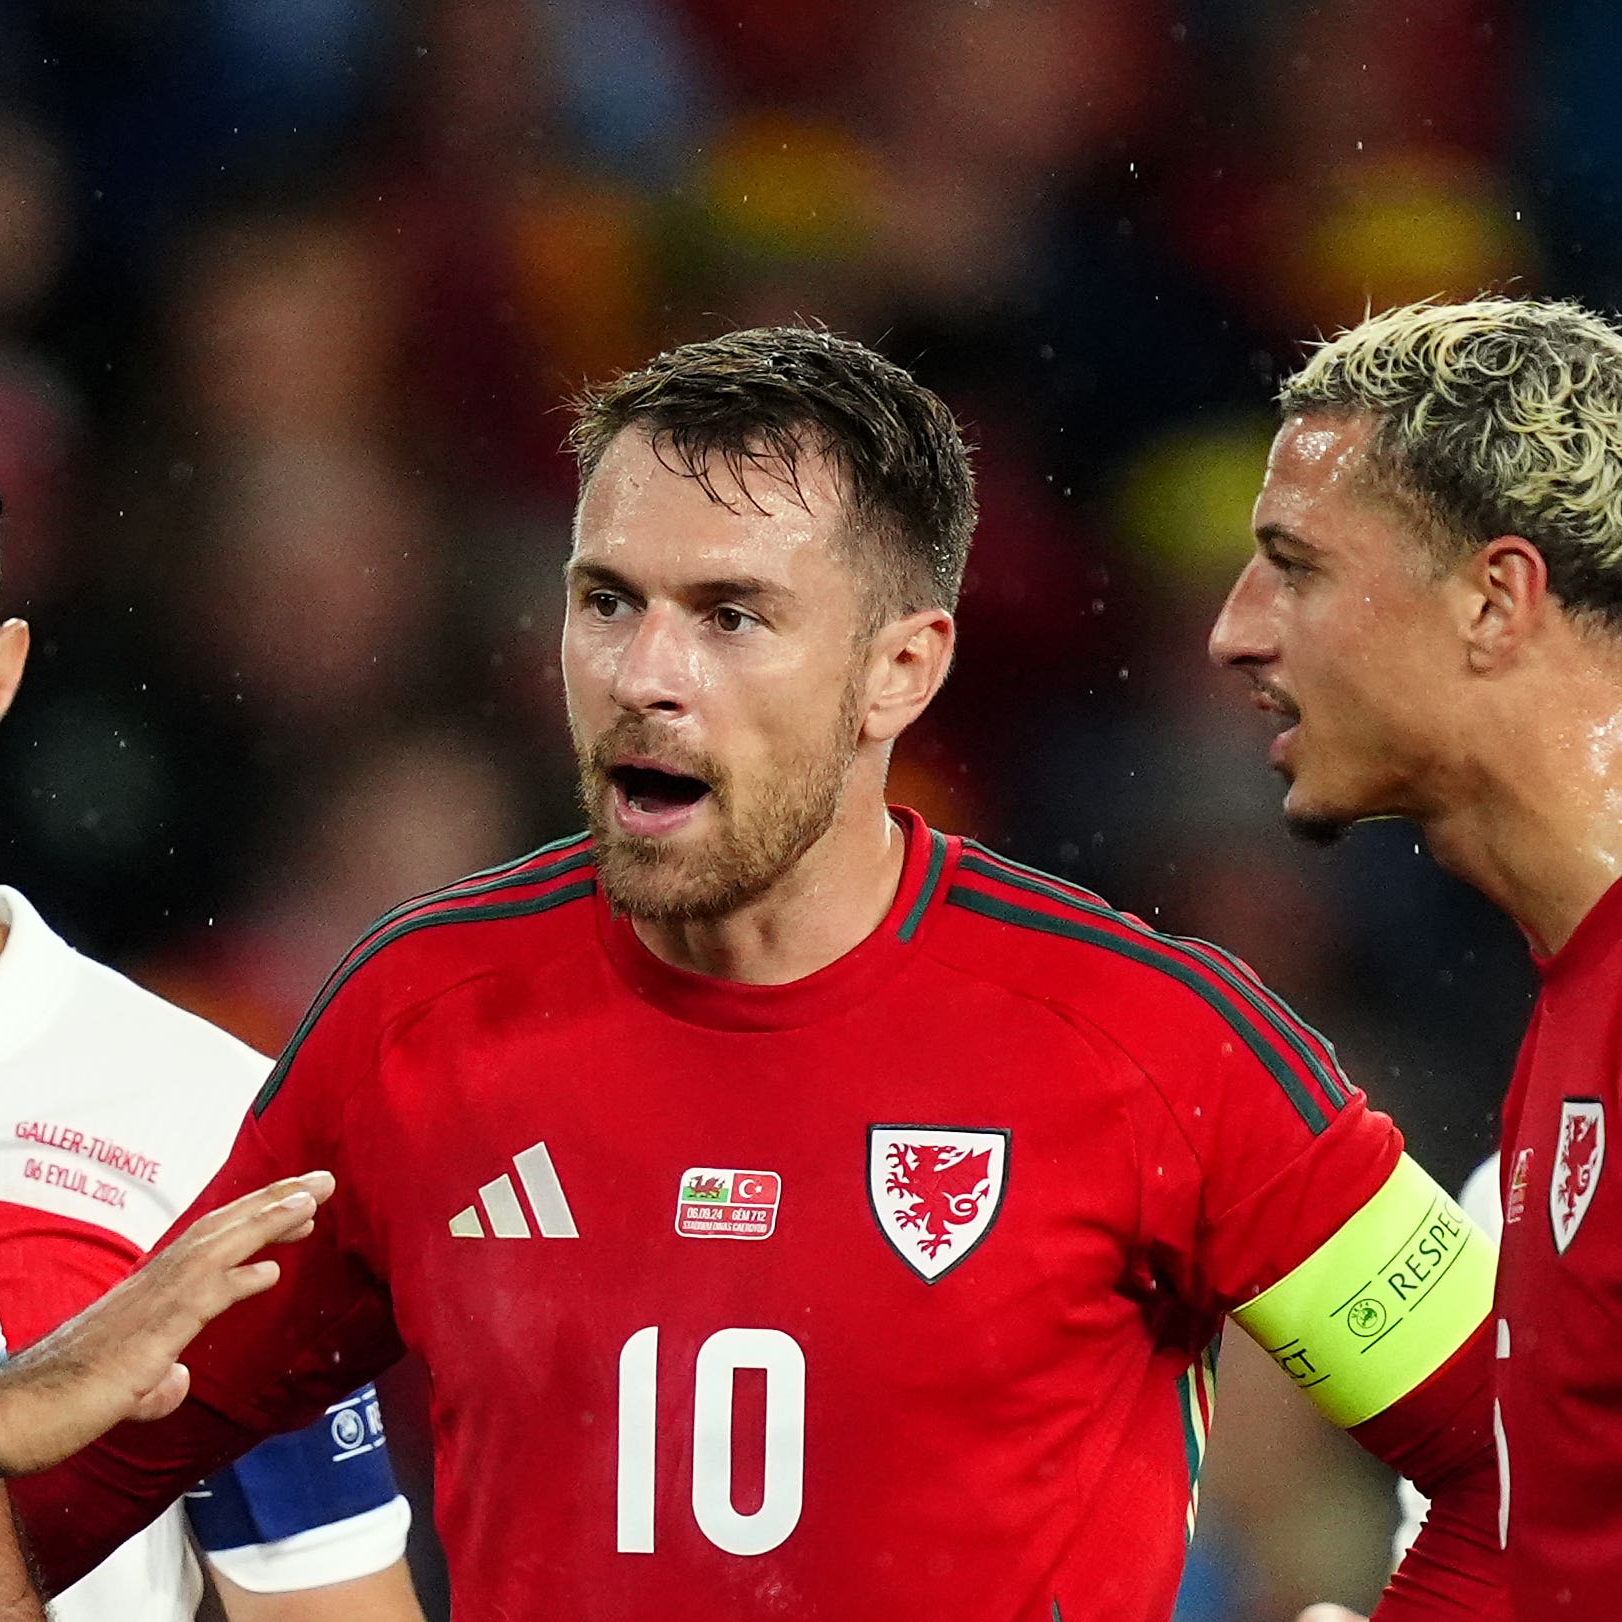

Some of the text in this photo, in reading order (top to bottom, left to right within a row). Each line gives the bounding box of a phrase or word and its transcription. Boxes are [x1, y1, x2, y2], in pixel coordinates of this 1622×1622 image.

[24, 1157, 43, 1181] 06
[91, 1179, 128, 1209] 2024
[616, 1325, 806, 1556] 10
